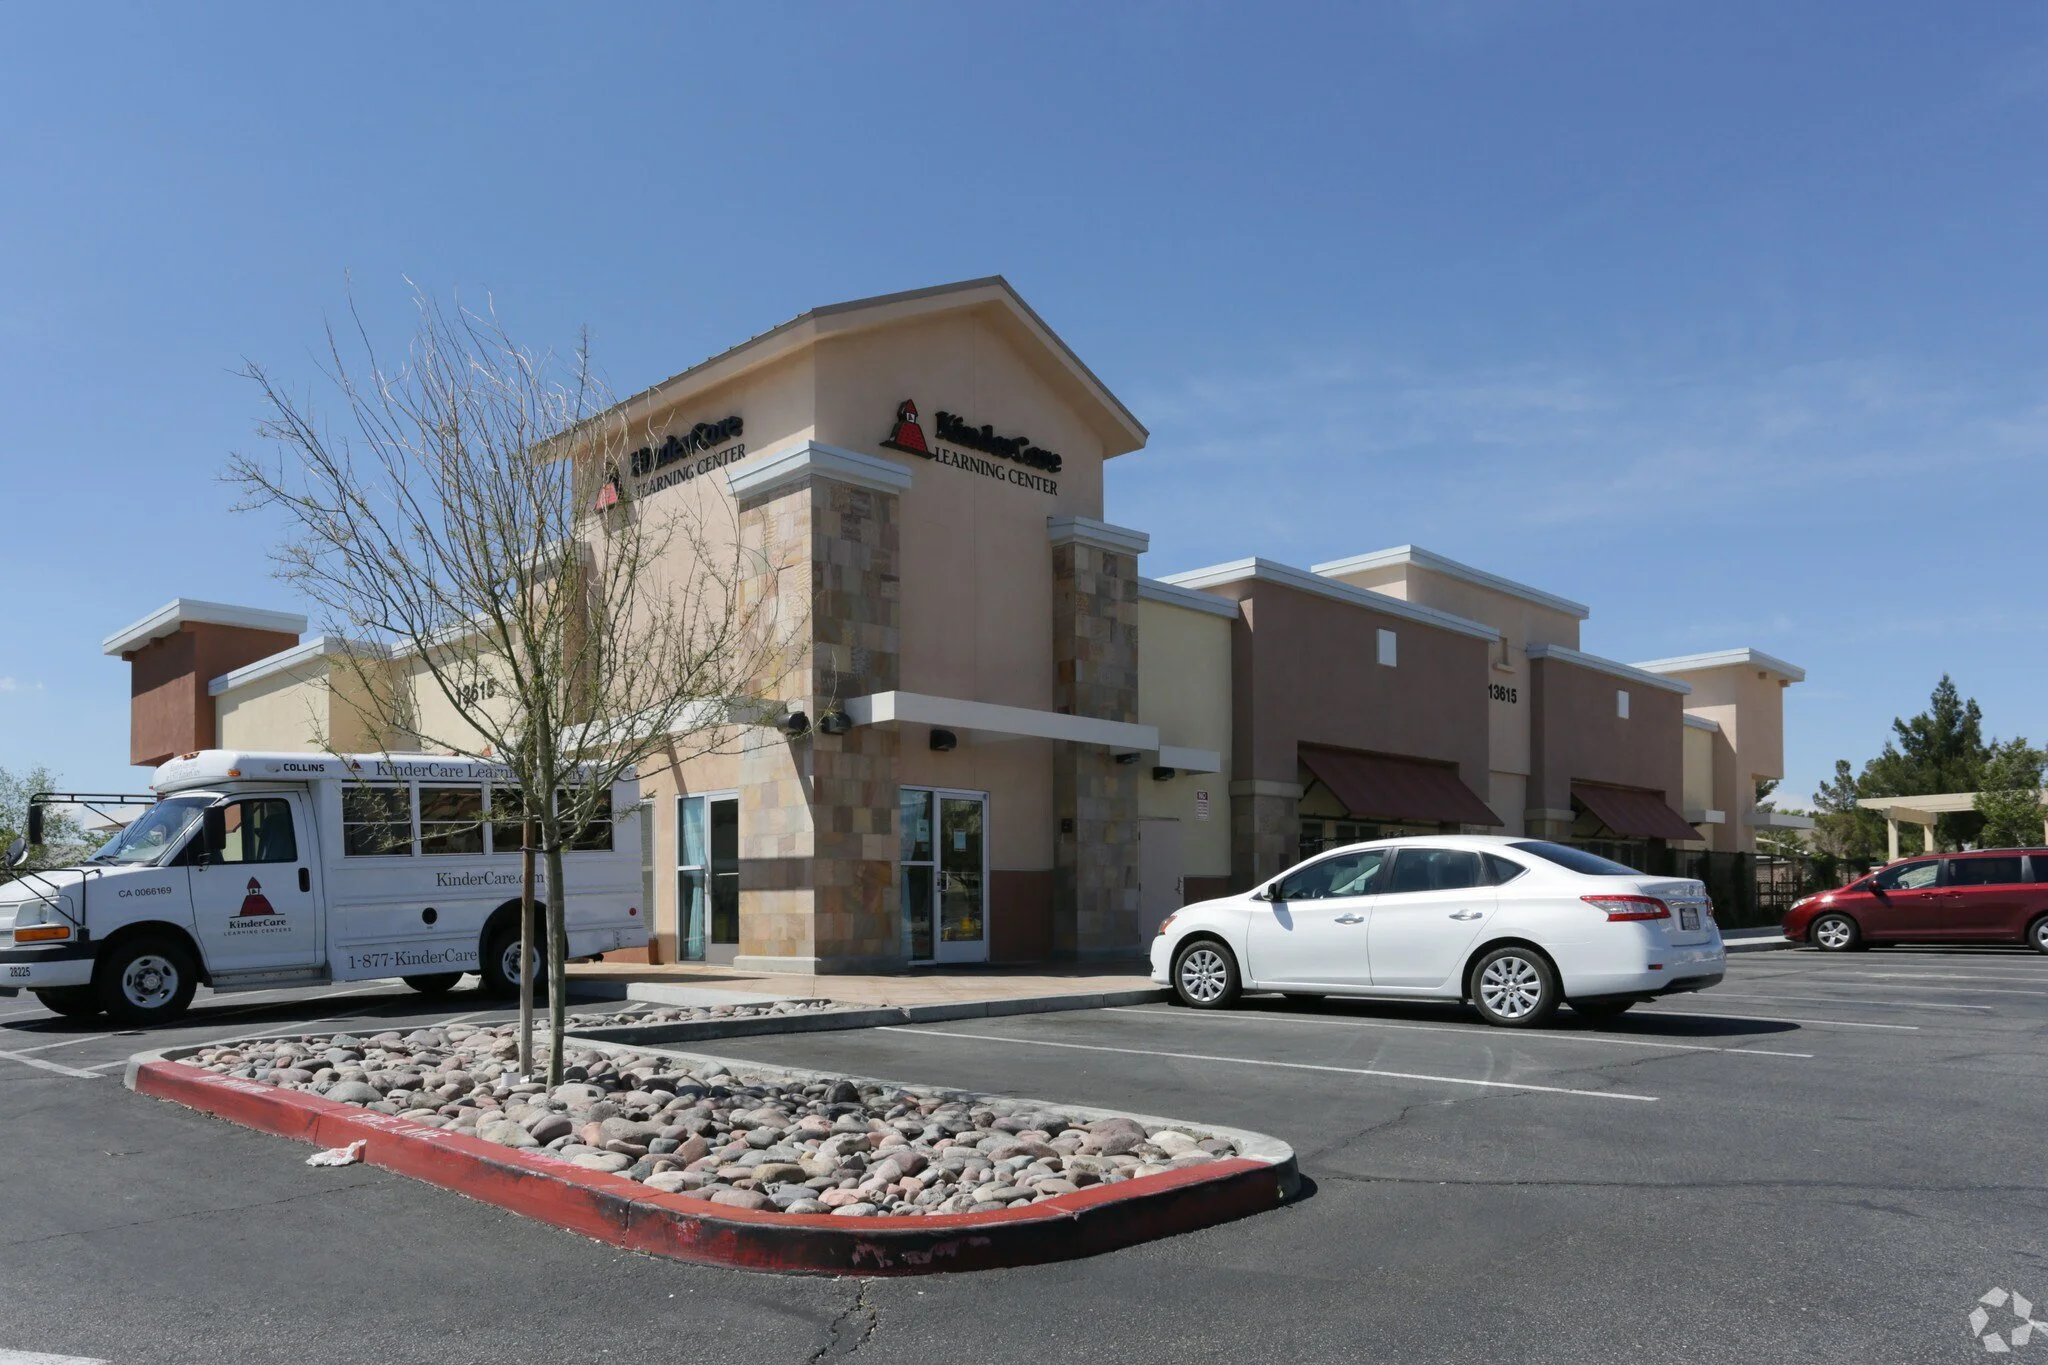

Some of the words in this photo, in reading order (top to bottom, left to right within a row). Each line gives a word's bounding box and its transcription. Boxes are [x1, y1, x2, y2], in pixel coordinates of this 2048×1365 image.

[637, 464, 694, 499] LEARNING
[697, 443, 746, 475] CENTER
[935, 447, 1005, 481] LEARNING
[1008, 468, 1058, 496] CENTER
[1488, 683, 1517, 704] 13615
[283, 763, 325, 772] COLLINS
[376, 761, 464, 778] KinderCare
[436, 871, 544, 887] KinderCare.cm
[118, 889, 133, 898] CA
[135, 886, 172, 897] 0066169
[229, 919, 287, 929] KinderCare
[223, 929, 258, 937] LEARNING
[349, 948, 477, 969] 1-877-KinderCare
[9, 966, 31, 977] 28225
